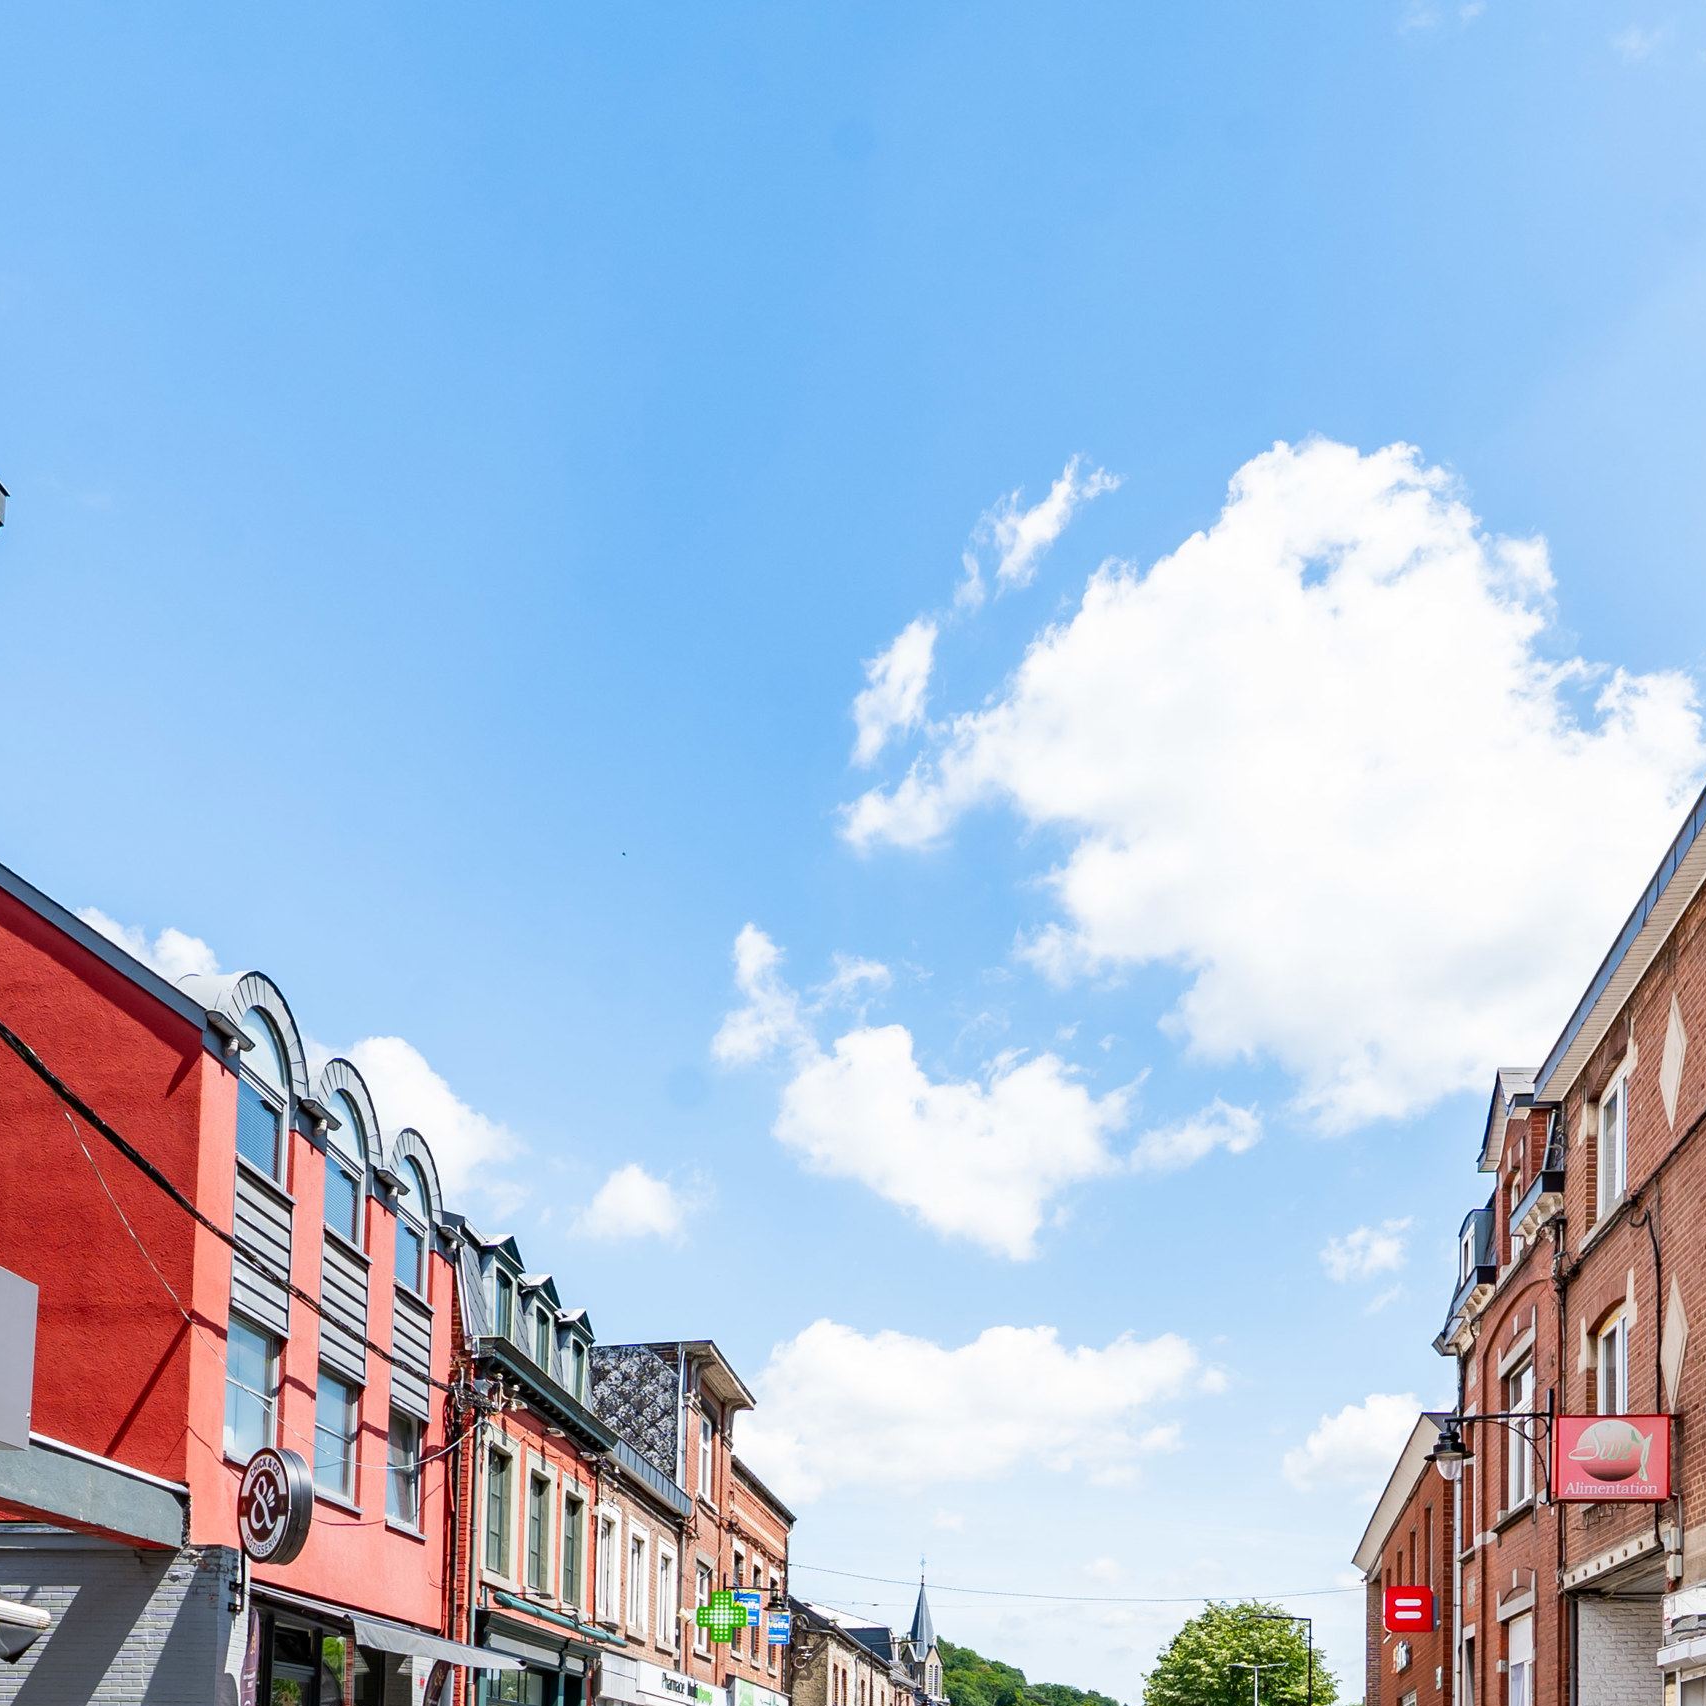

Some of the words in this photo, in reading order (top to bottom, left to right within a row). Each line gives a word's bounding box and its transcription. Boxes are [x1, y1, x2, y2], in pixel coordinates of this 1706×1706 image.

[249, 1457, 267, 1478] CHICK
[273, 1461, 281, 1477] CO
[1565, 1482, 1658, 1495] Alimentation
[245, 1531, 279, 1555] RÔTISSERIE
